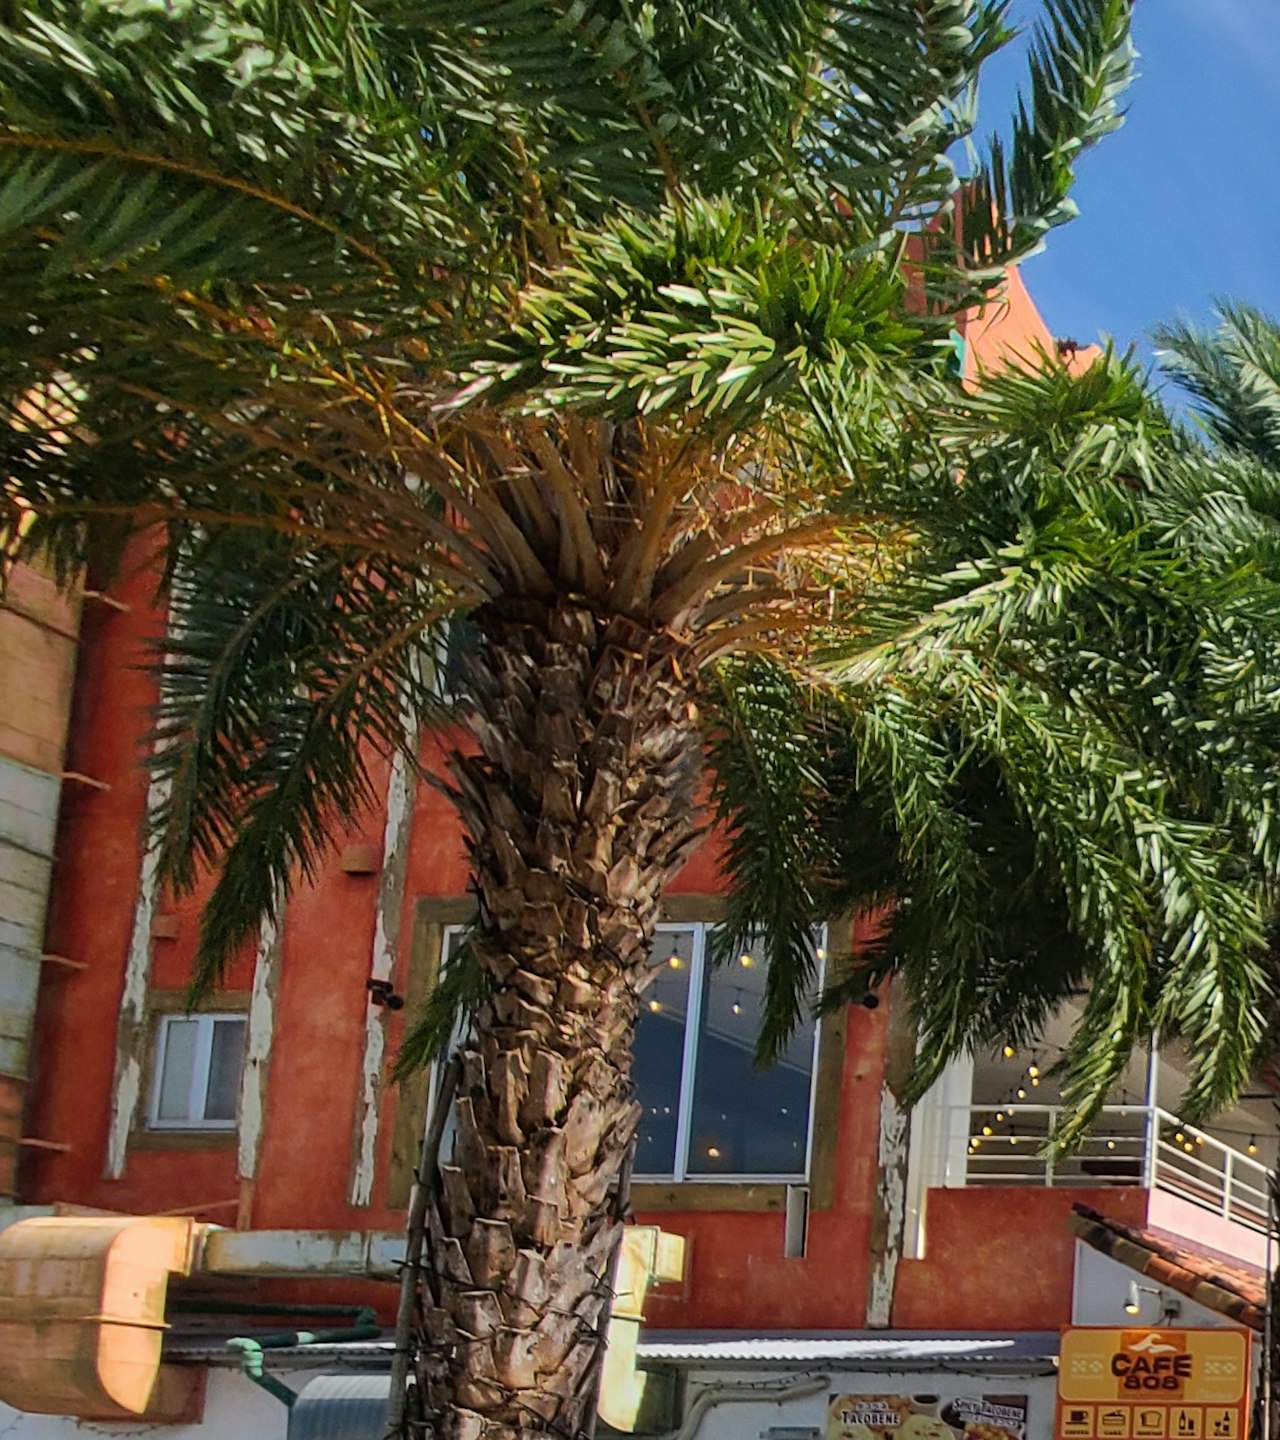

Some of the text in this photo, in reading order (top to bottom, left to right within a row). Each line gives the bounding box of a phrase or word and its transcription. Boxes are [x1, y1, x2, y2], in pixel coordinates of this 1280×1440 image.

[1111, 1353, 1192, 1378] CAFE
[1124, 1376, 1179, 1390] 808
[842, 1410, 899, 1424] TACOBENE
